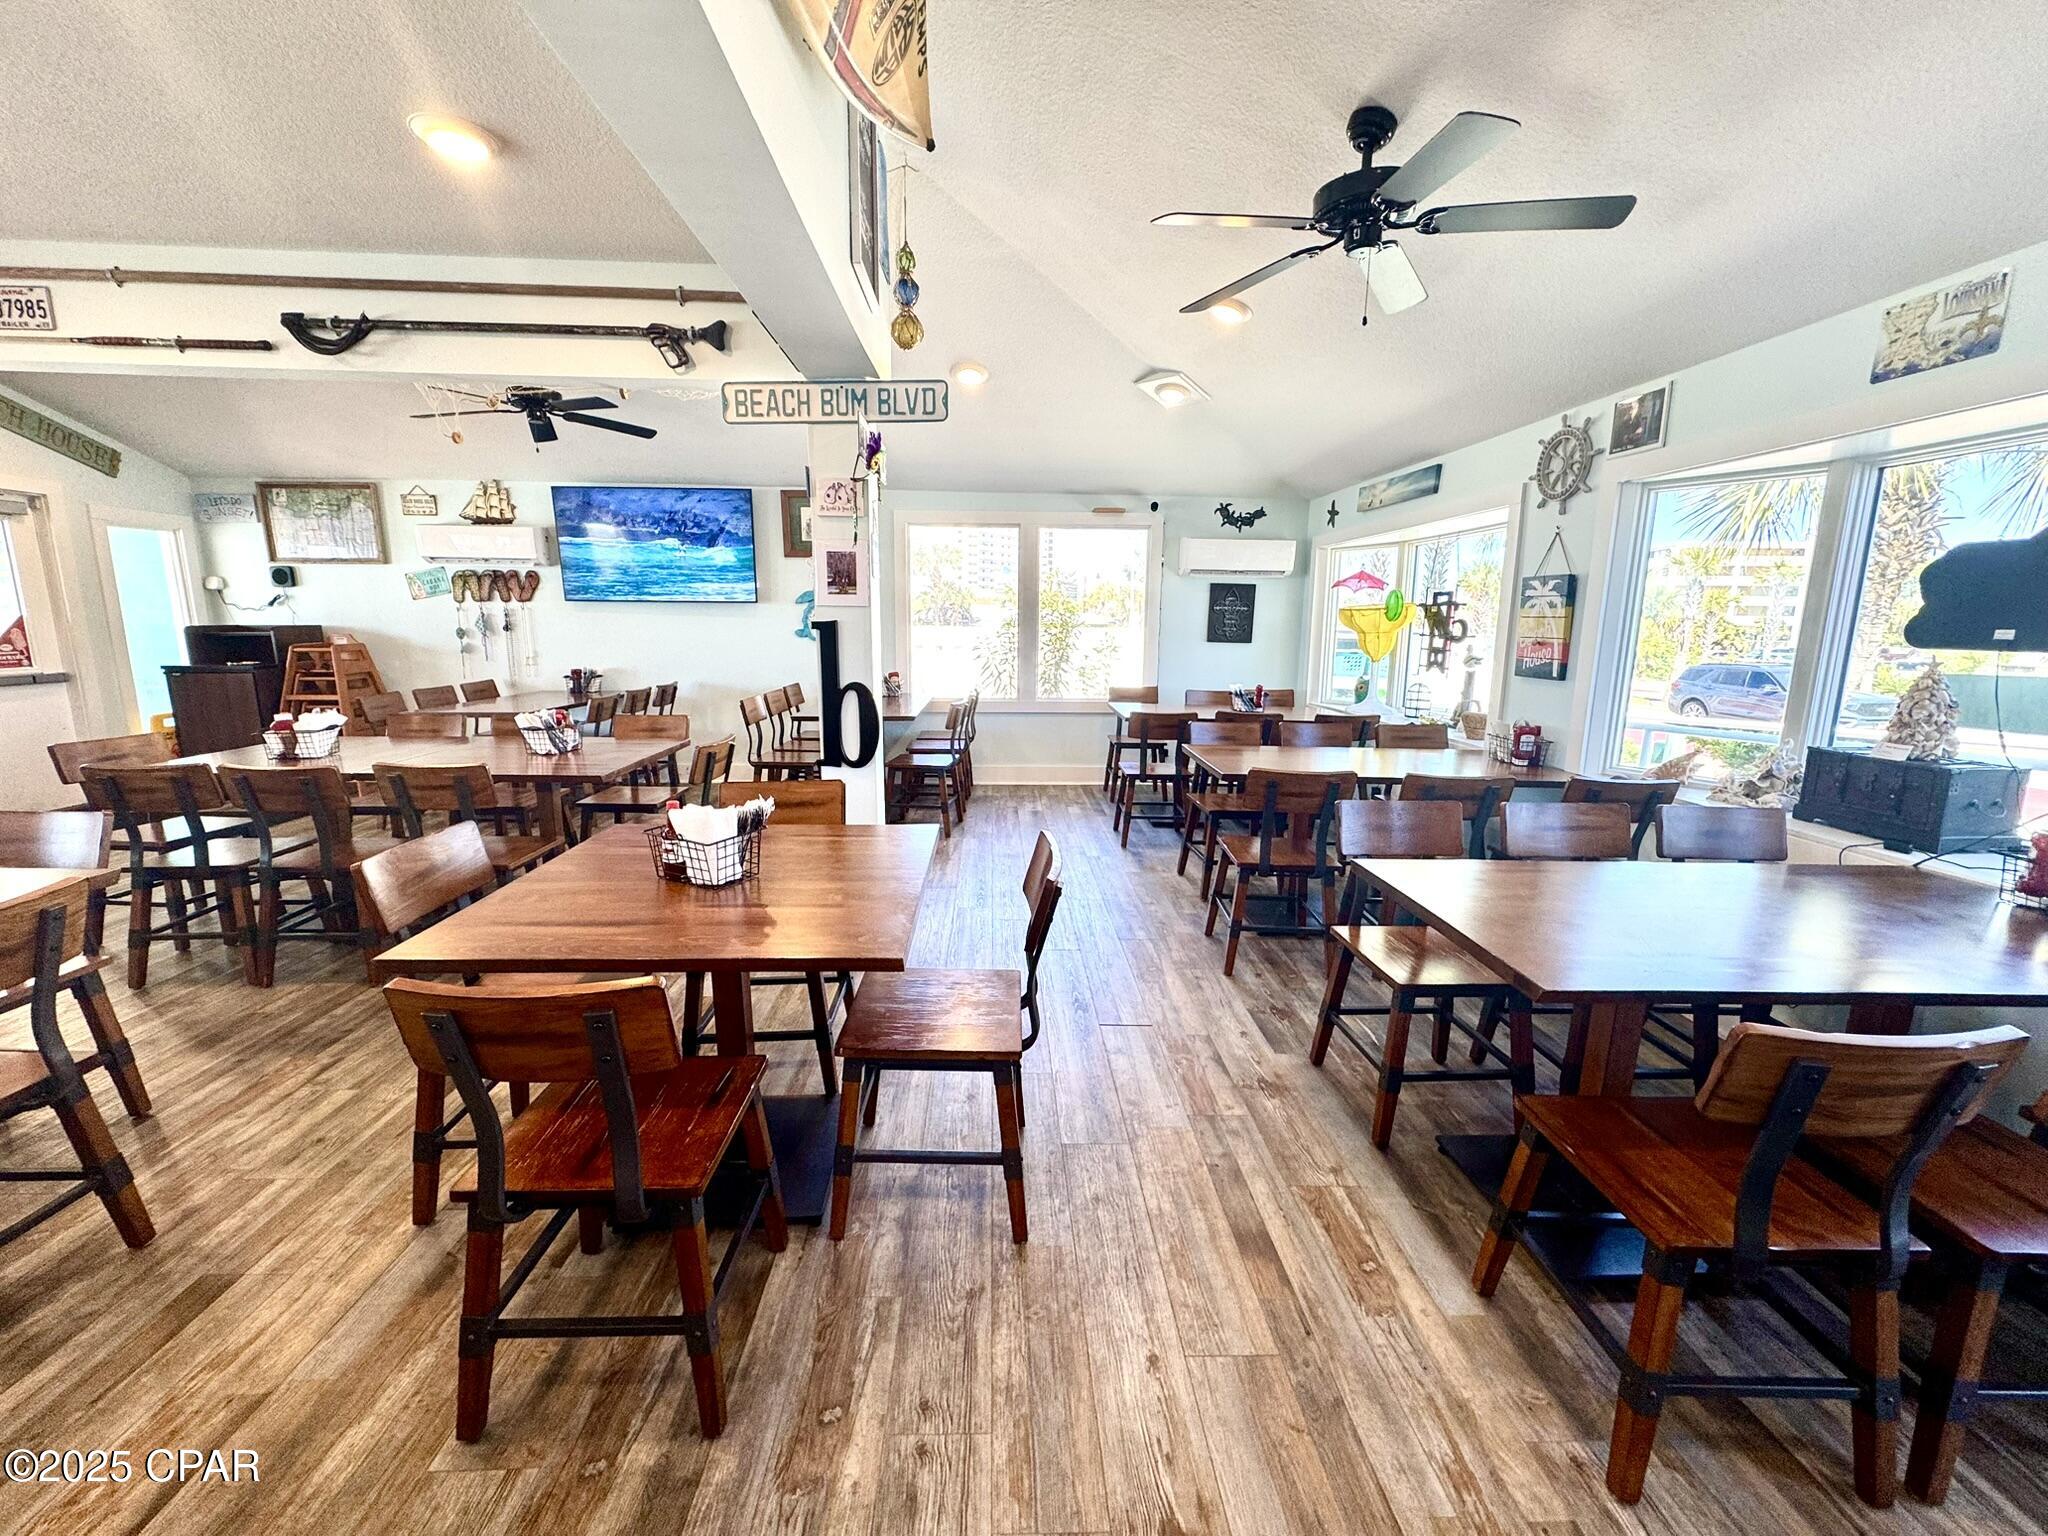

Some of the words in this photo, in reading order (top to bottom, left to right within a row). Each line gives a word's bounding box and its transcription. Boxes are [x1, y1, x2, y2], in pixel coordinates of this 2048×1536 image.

[734, 389, 810, 418] BEACH
[821, 388, 868, 416] BUM
[877, 388, 937, 415] BLVD
[34, 417, 108, 468] HOUSE
[1522, 647, 1552, 670] House
[811, 620, 880, 768] b
